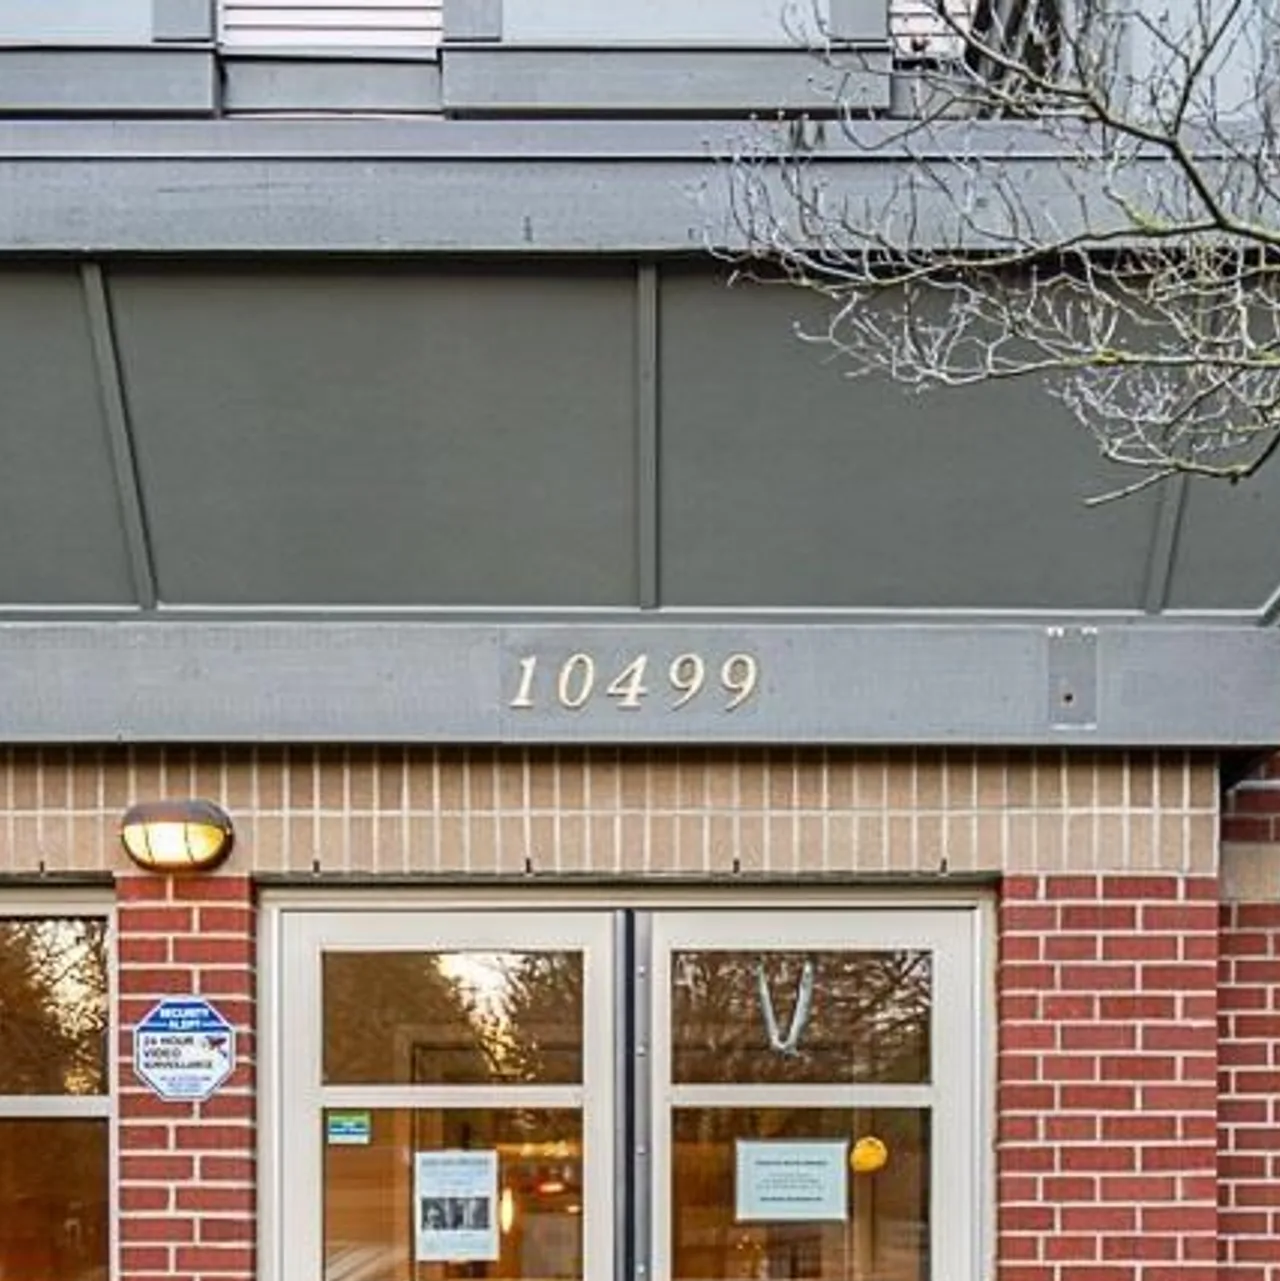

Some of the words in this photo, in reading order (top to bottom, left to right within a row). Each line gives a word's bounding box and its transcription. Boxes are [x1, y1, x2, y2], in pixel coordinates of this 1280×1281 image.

[509, 652, 758, 712] 10499
[160, 1008, 209, 1018] SECURITY
[168, 1019, 200, 1029] ALERT
[144, 1036, 158, 1046] 24
[160, 1036, 194, 1046] HOUR
[144, 1048, 182, 1058] VIDEO
